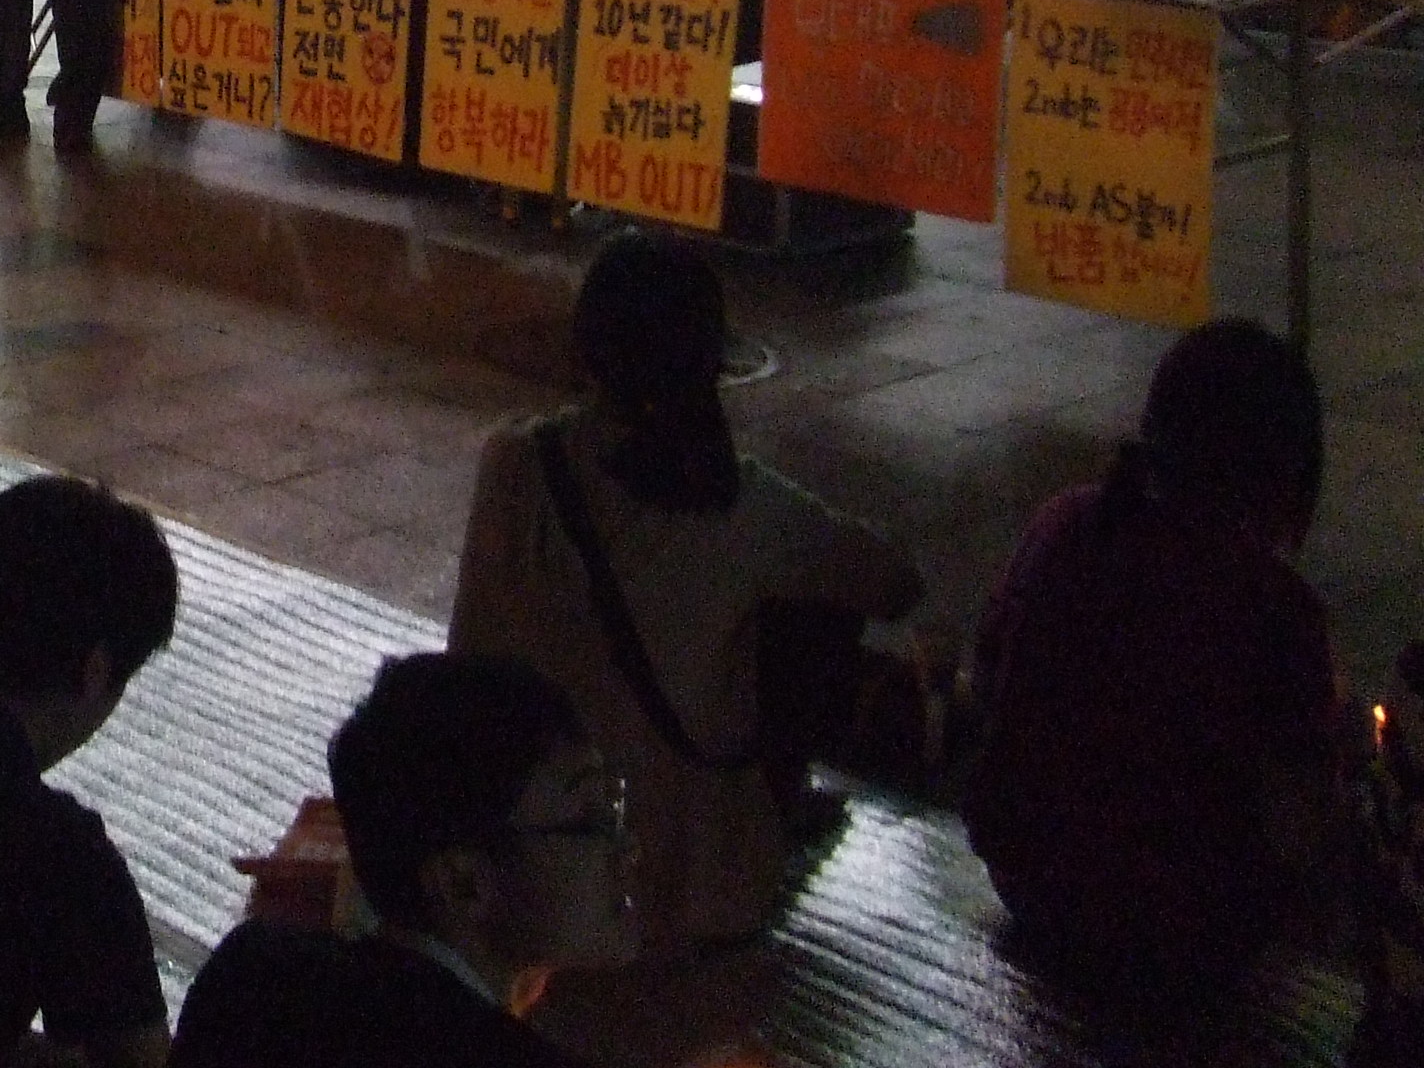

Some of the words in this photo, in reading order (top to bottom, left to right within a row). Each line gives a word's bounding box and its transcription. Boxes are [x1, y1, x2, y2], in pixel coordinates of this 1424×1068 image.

[293, 30, 347, 83] 전면
[439, 8, 562, 86] 국민에게
[290, 78, 402, 152] 재협상!
[430, 83, 551, 174] 항복하라
[572, 137, 628, 202] MB
